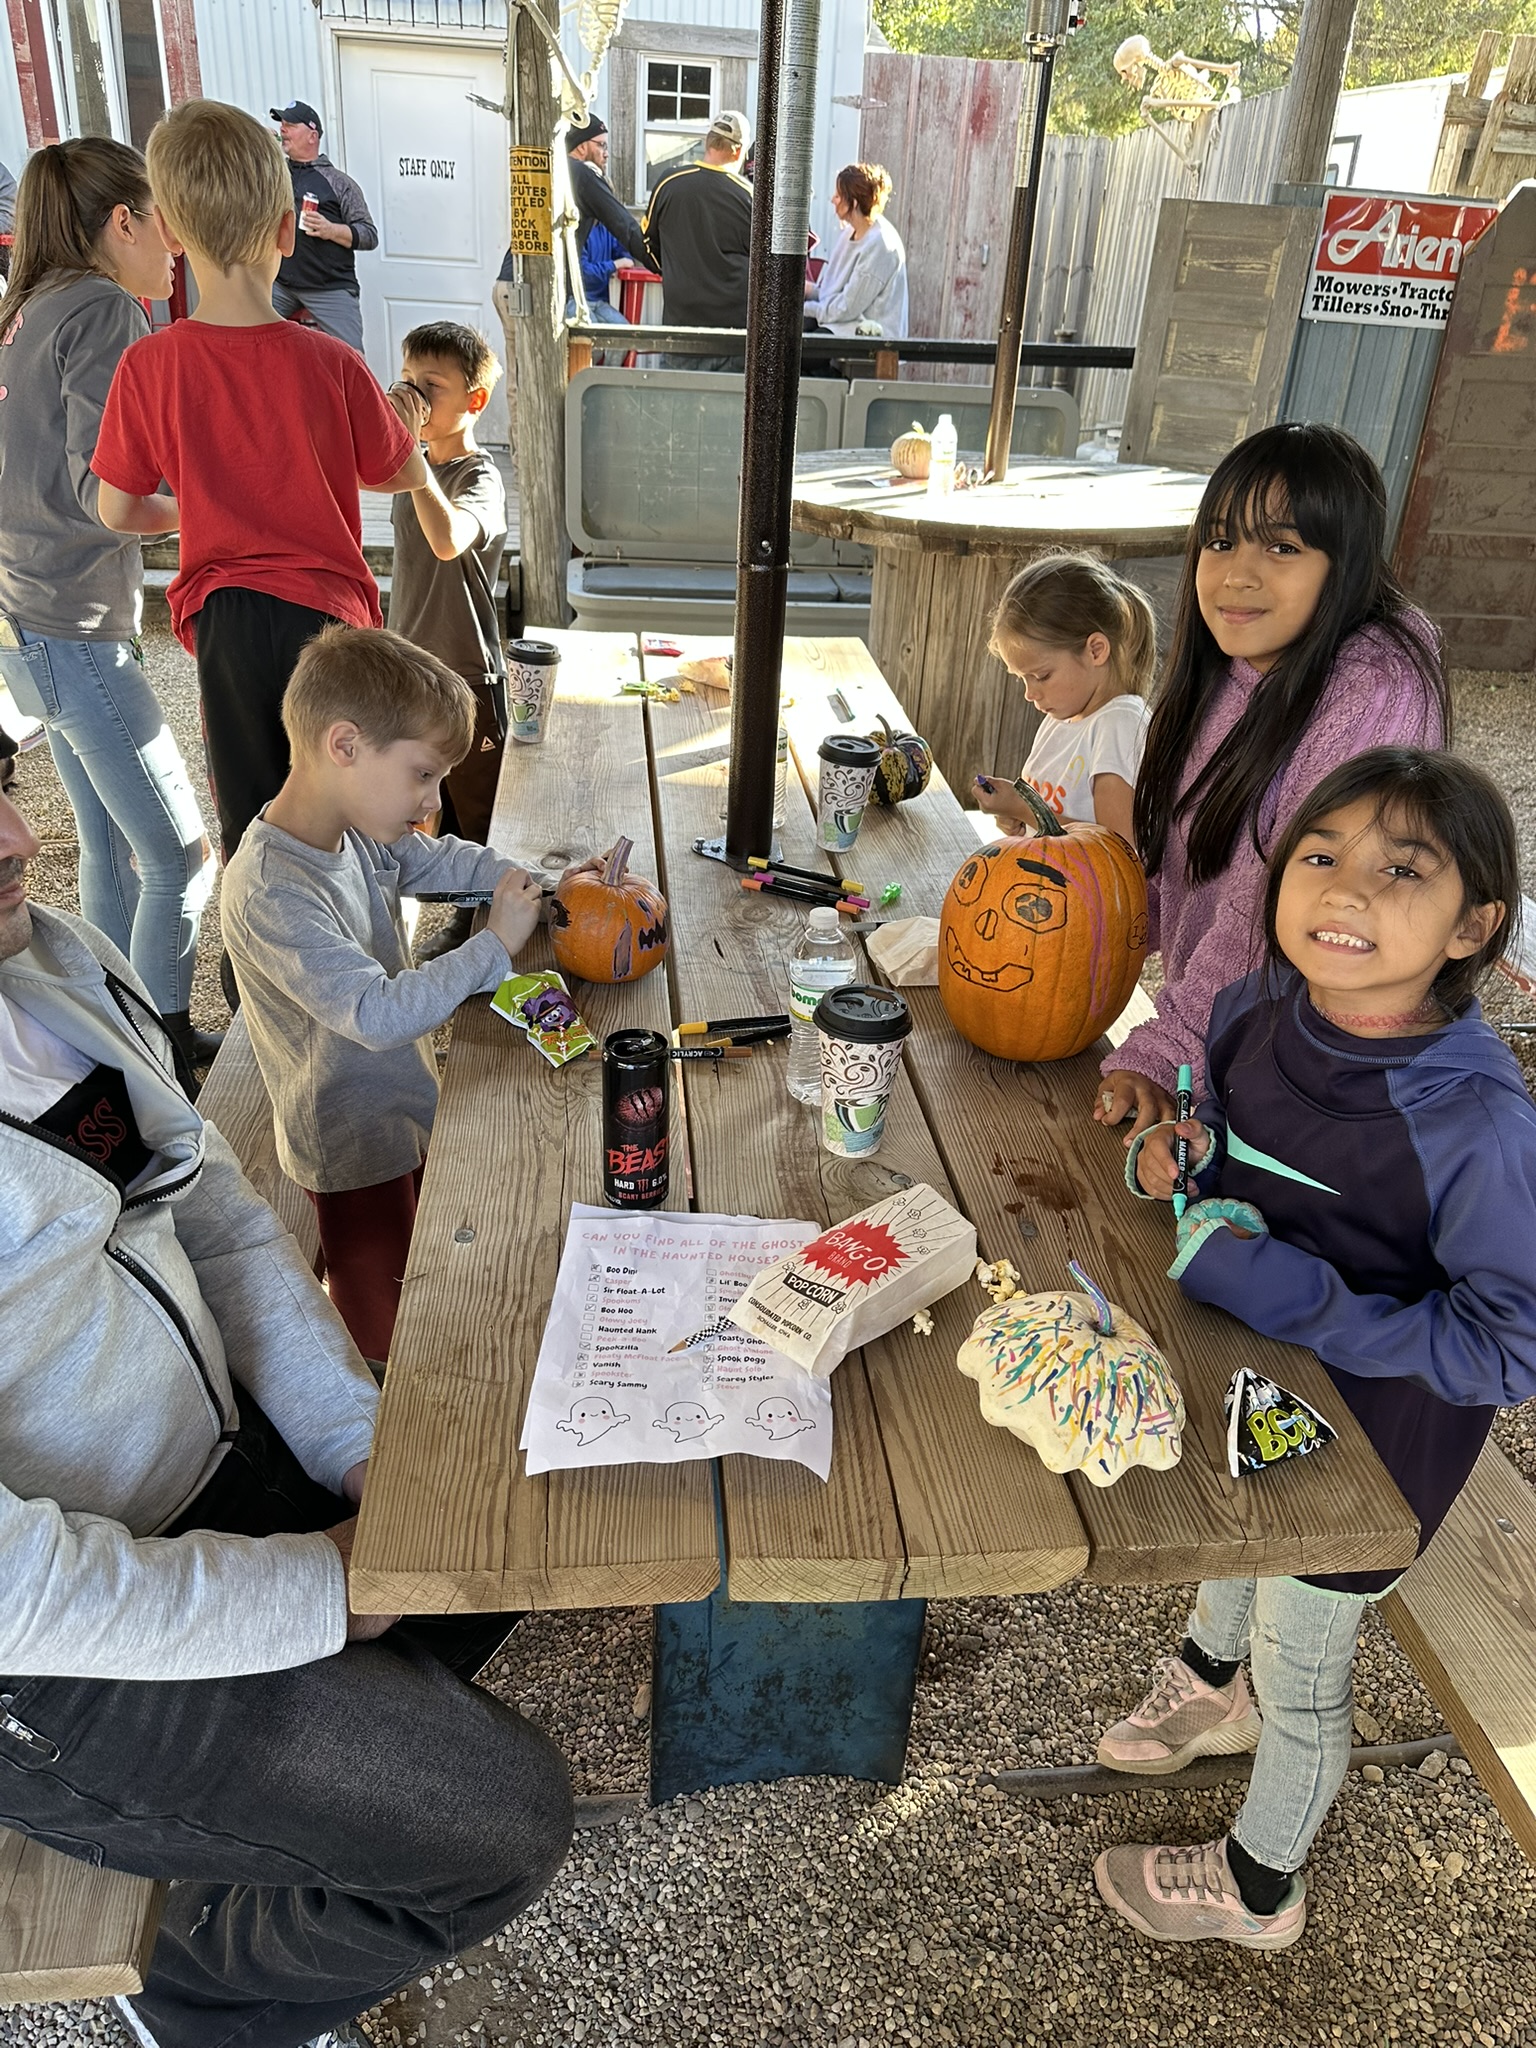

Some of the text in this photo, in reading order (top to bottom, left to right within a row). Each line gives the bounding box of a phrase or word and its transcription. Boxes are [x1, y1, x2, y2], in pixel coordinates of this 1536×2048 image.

[399, 157, 455, 180] STAFF ONLY
[511, 185, 547, 197] PUTES
[514, 207, 527, 218] BY
[511, 218, 536, 229] OCK
[511, 230, 539, 240] APER
[511, 240, 549, 251] SSORS
[672, 1050, 703, 1058] ACRYLIC
[606, 1135, 668, 1175] BEAS
[1178, 1140, 1187, 1172] MARKER
[614, 1178, 635, 1190] HARD
[582, 1232, 608, 1241] CAN
[613, 1232, 640, 1240] YOU
[645, 1234, 675, 1246] FIND
[680, 1239, 703, 1247] ALL
[709, 1239, 727, 1248] OF
[731, 1241, 757, 1249] THE
[613, 1245, 780, 1265] IN THE HAUNTED HOUSE?
[828, 1251, 853, 1268] BRAND
[606, 1266, 620, 1274] Boo
[604, 1277, 632, 1287] Casper
[733, 1280, 748, 1288] Boo
[603, 1286, 665, 1295] Sir Float-A-Lot
[601, 1296, 641, 1305] Spookums
[747, 1296, 782, 1323] CONSOLIDATED
[780, 1319, 804, 1335] POPCORN
[599, 1316, 648, 1326] Glowy Joey
[598, 1325, 633, 1334] Haunted
[778, 1328, 791, 1339] IOWA
[718, 1335, 744, 1345] Toasty
[595, 1344, 639, 1353] Spookzilla
[717, 1345, 741, 1353] Ghost
[594, 1353, 621, 1361] Floaty
[624, 1354, 658, 1362] McFloat
[717, 1354, 766, 1364] Spook Dogg
[717, 1364, 761, 1372] Haunt Solo
[590, 1370, 634, 1378] Spookster
[716, 1375, 746, 1383] Scarey
[589, 1379, 648, 1389] Scary Sammy
